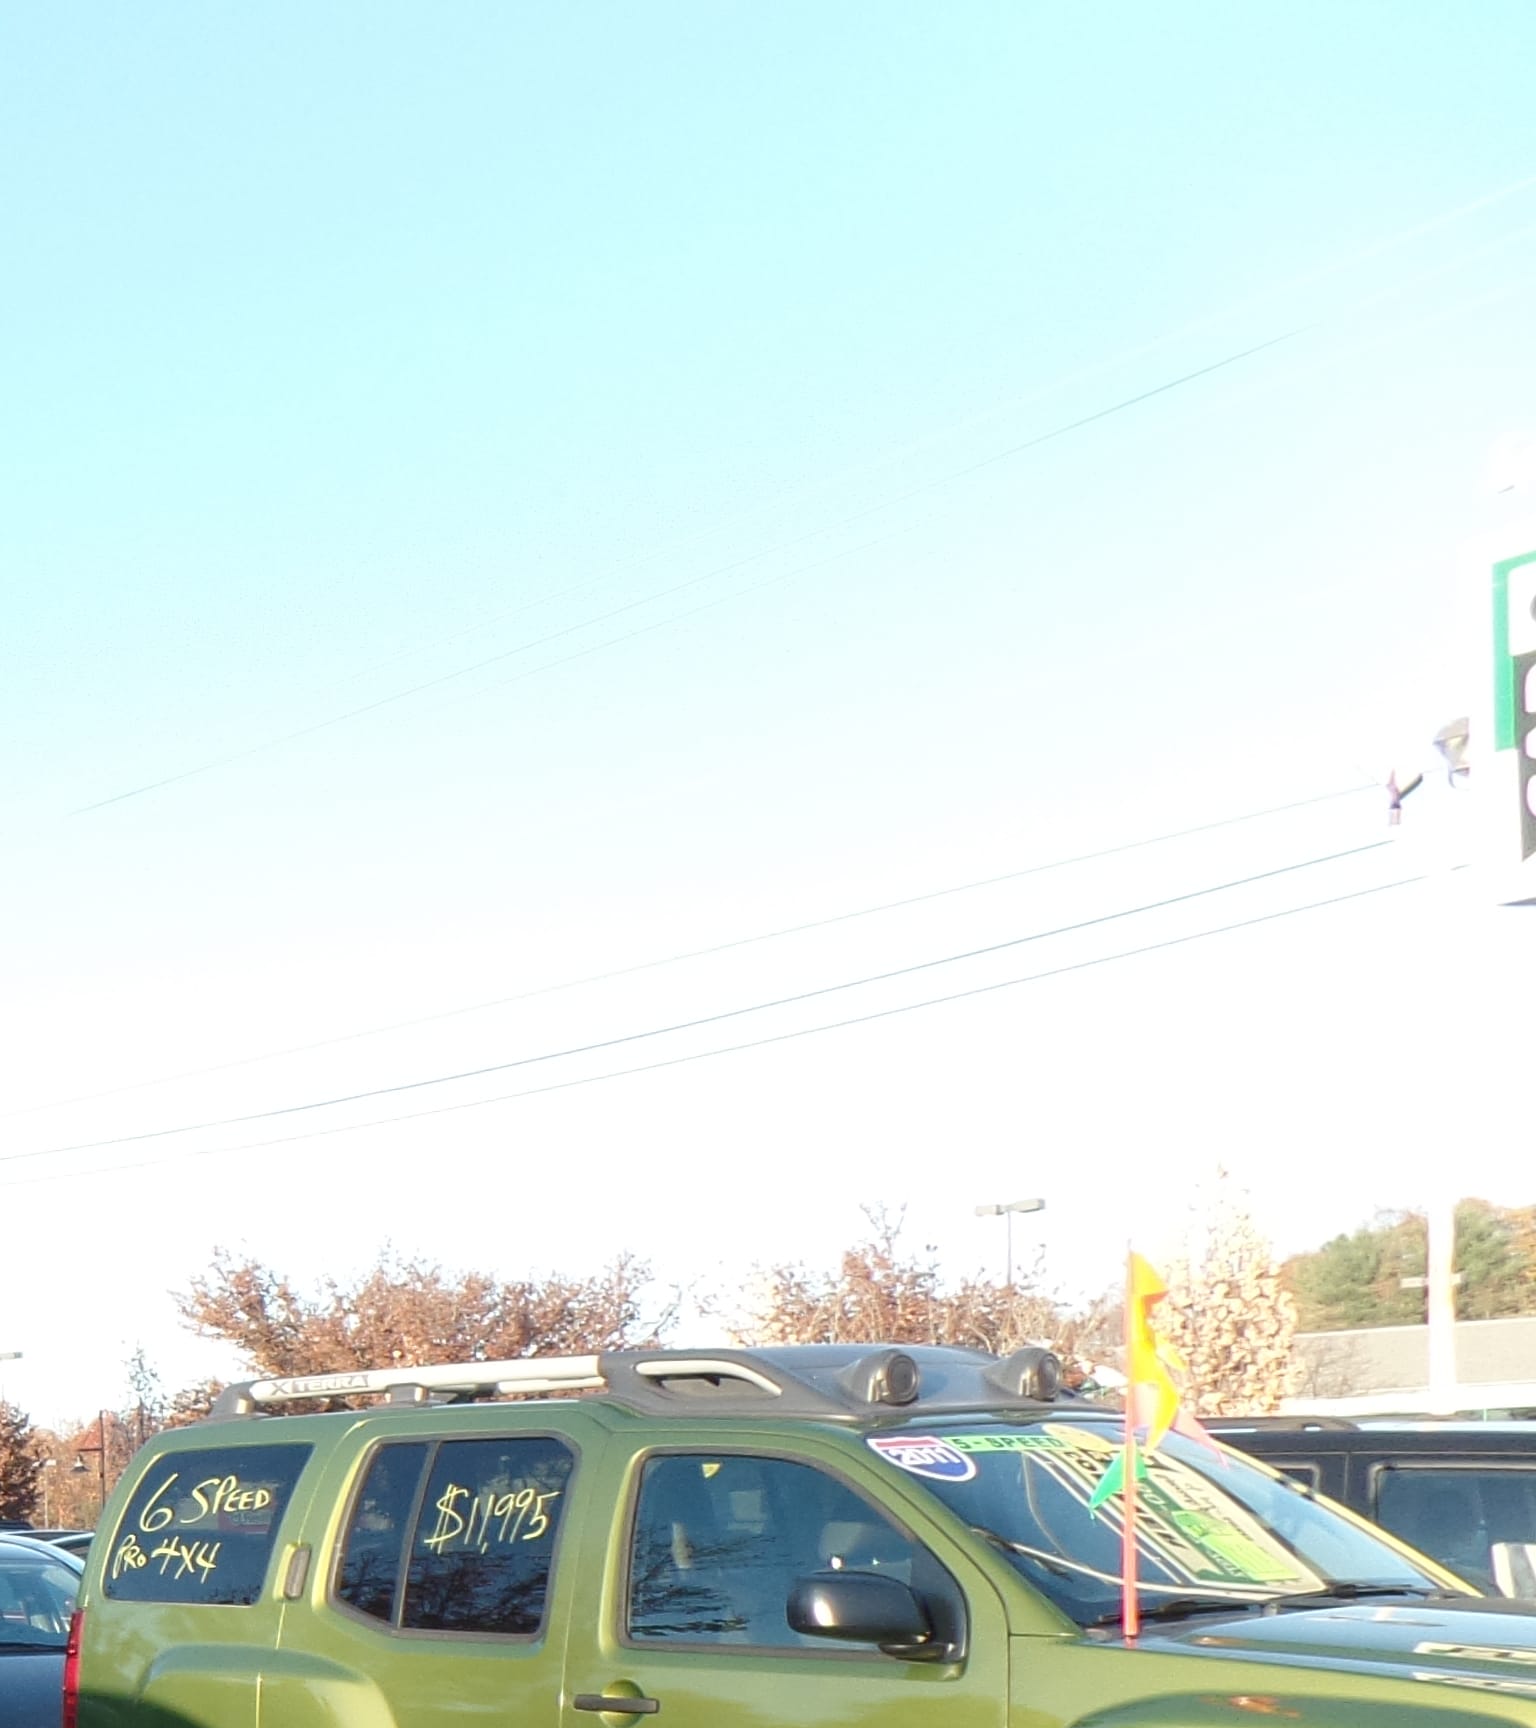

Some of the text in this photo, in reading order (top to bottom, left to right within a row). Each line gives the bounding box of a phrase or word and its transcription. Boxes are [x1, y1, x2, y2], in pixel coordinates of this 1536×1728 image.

[139, 1473, 178, 1533] 6
[180, 1475, 270, 1524] SPEED
[424, 1483, 562, 1555] $11,995
